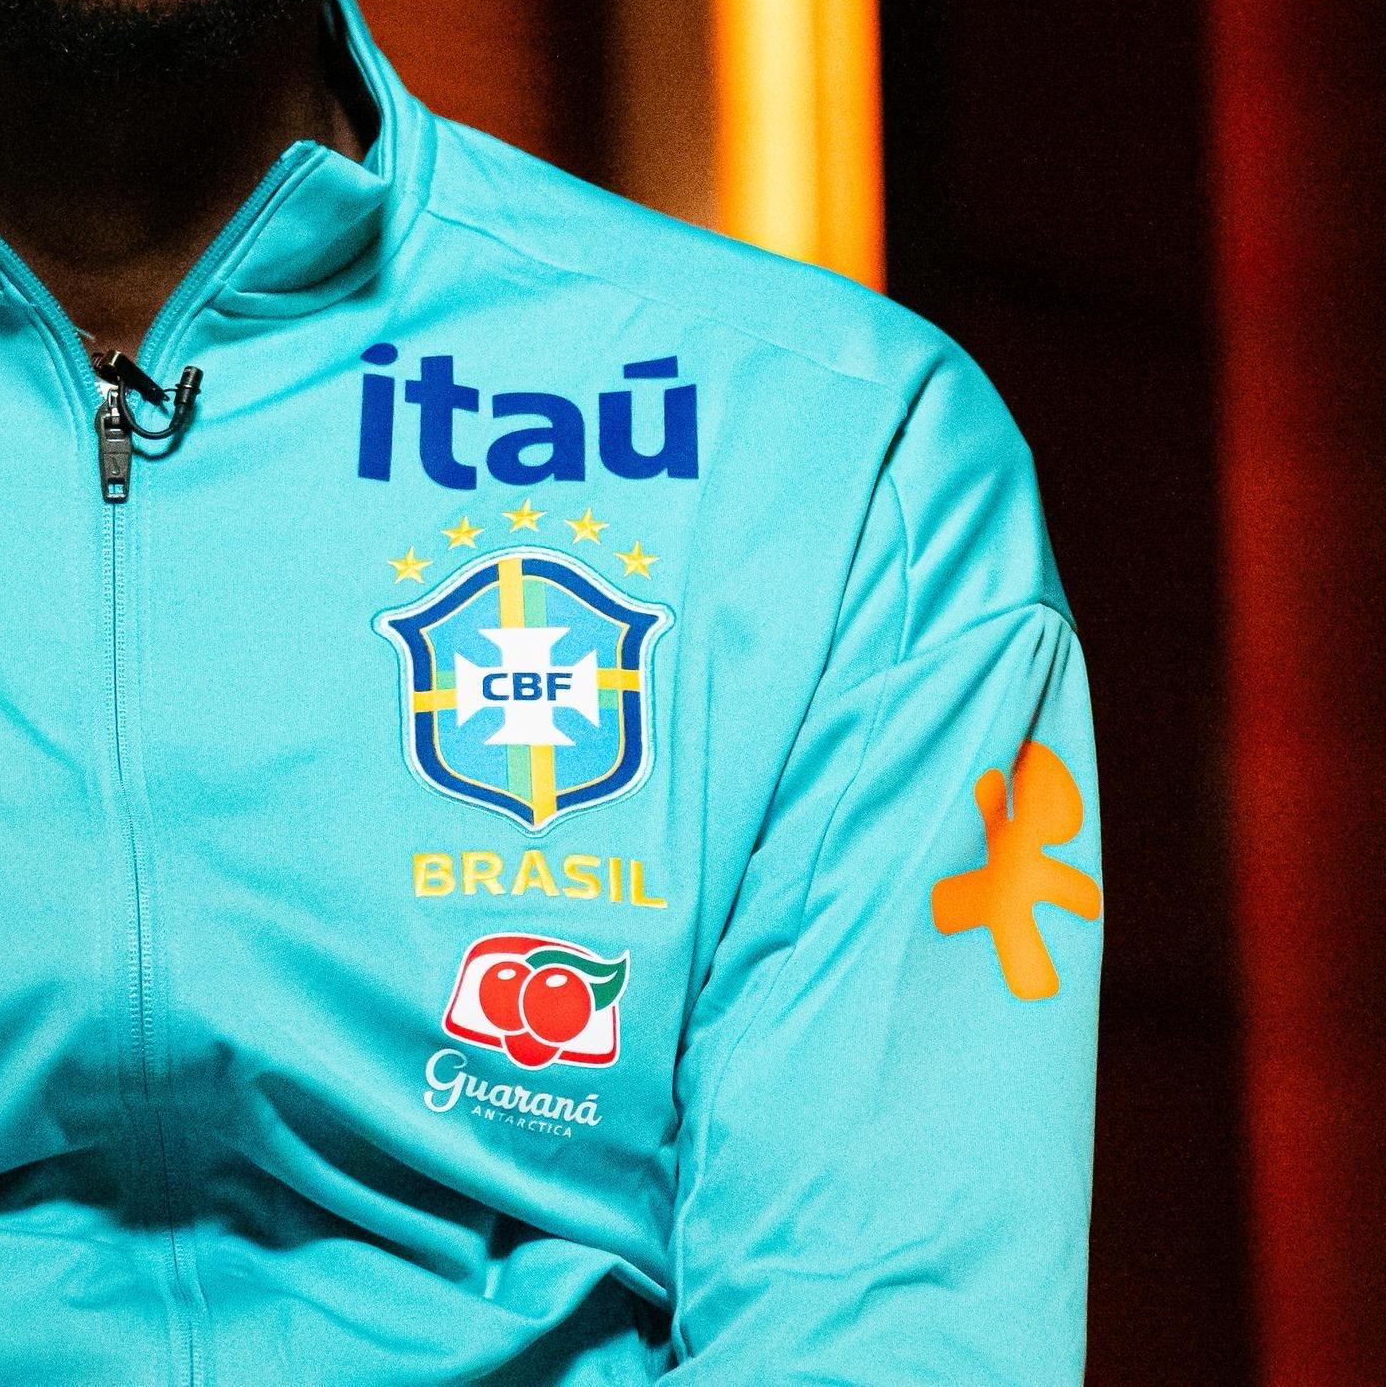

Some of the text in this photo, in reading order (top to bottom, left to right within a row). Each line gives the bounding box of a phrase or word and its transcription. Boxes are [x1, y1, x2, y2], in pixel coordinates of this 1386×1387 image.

[358, 342, 699, 490] itaú
[482, 672, 573, 701] CBF
[413, 849, 668, 909] BRASIL
[423, 1048, 602, 1127] Guaraná
[471, 1105, 573, 1139] ANTARCTICA
